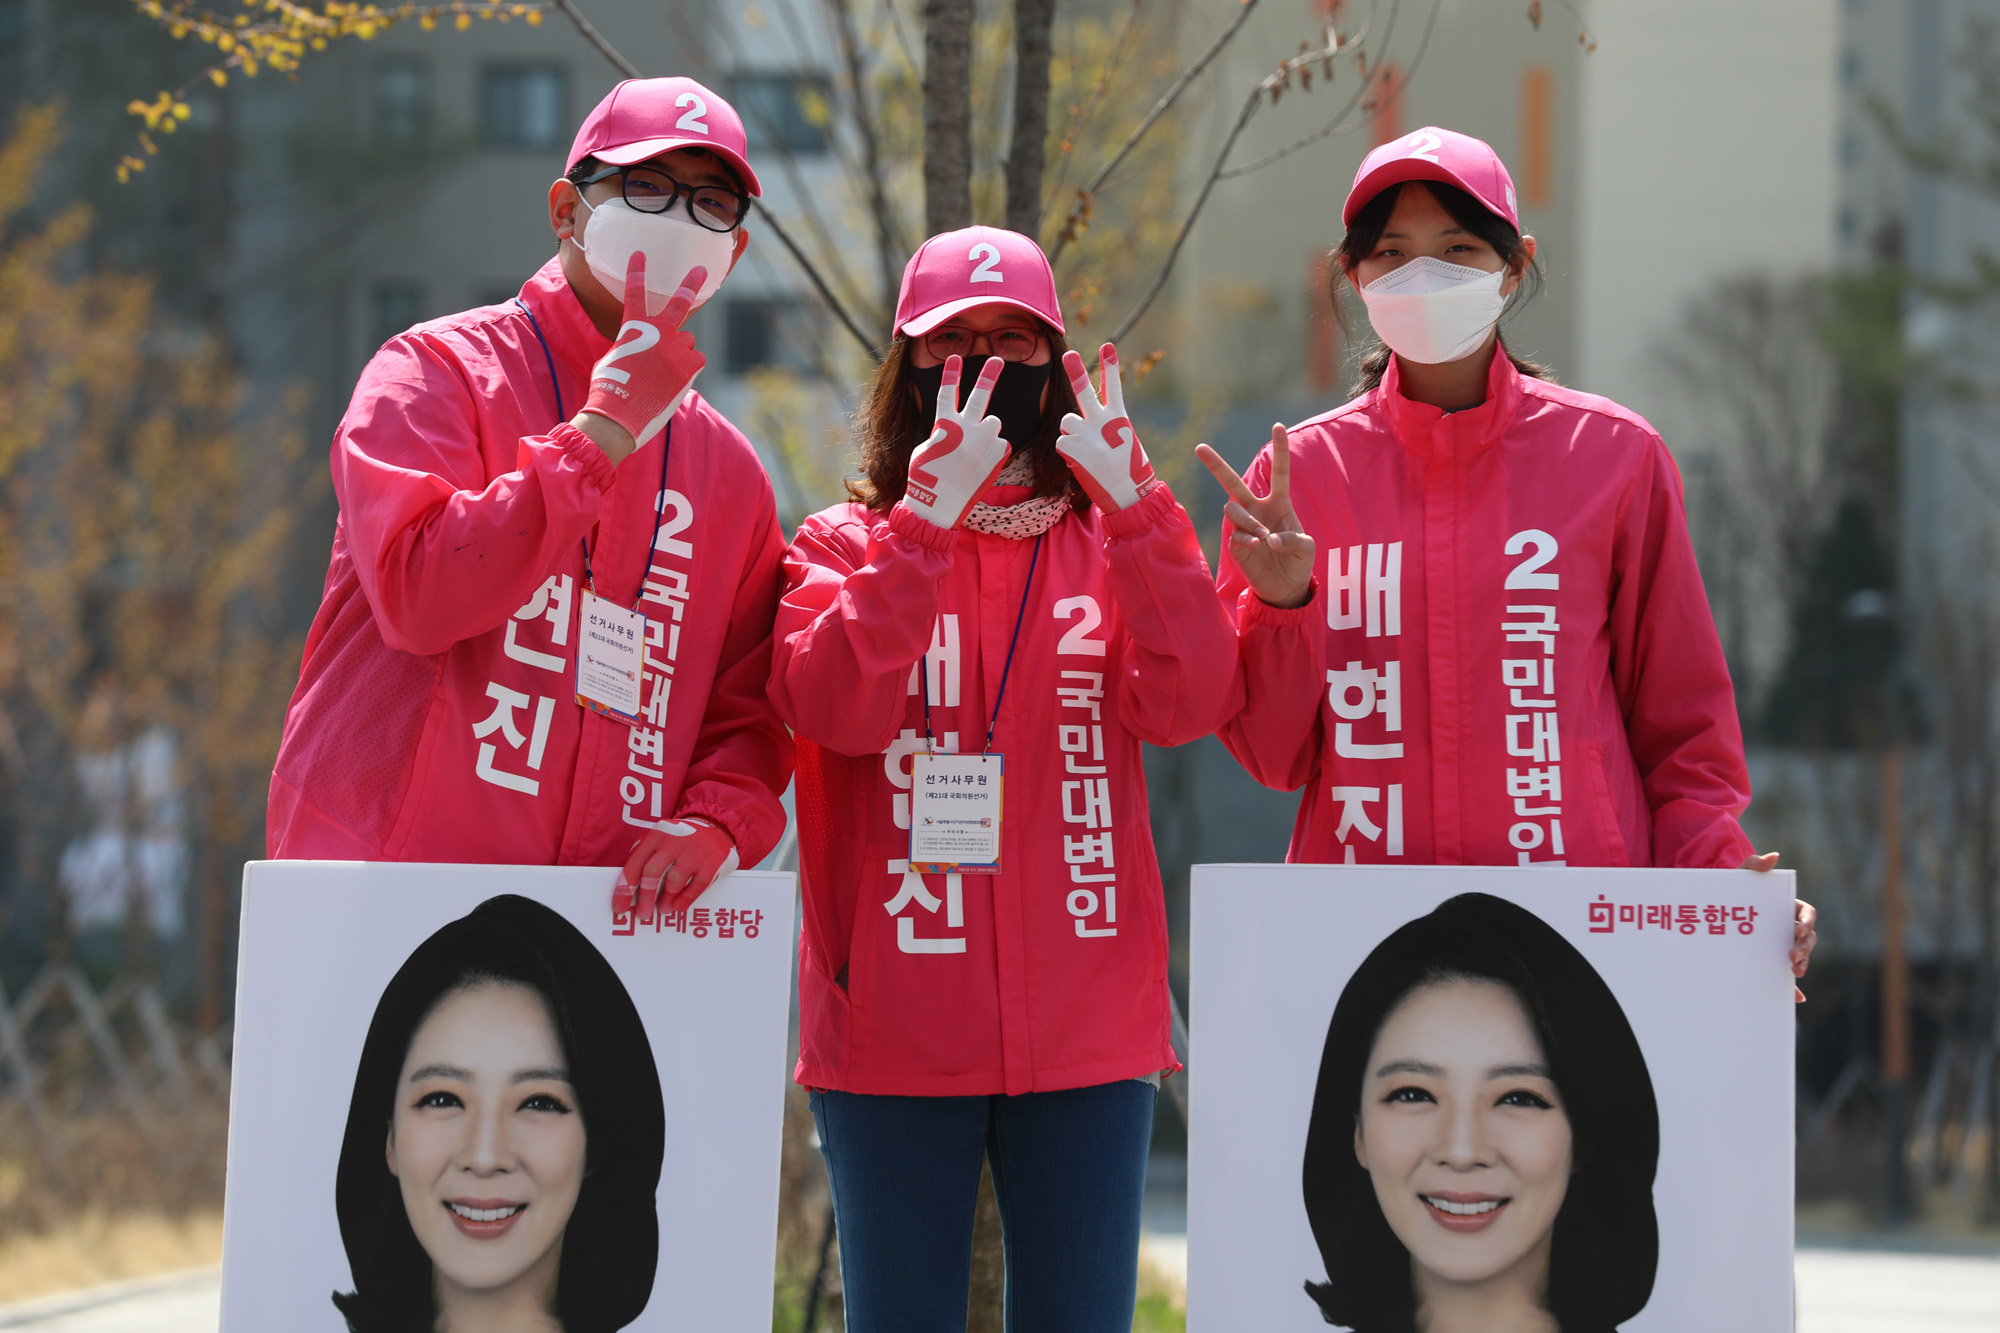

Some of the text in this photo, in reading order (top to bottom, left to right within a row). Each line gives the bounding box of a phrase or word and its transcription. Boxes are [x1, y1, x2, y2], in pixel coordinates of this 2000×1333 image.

[675, 92, 709, 135] 2
[1408, 133, 1442, 164] 2
[968, 243, 1004, 283] 2
[591, 320, 661, 385] 2
[908, 418, 964, 489] 2
[1101, 417, 1154, 485] 2
[651, 489, 694, 559] 2
[1504, 529, 1560, 590] 2
[589, 614, 634, 640] 선거사무원
[1053, 594, 1106, 656] 2
[1501, 604, 1566, 867] 국민대변인
[925, 774, 987, 786] 선거사무원
[925, 791, 989, 801] (제21대 국회의원선거)
[1056, 670, 1118, 938] 국민대변인
[1619, 903, 1759, 935] 미래통합당
